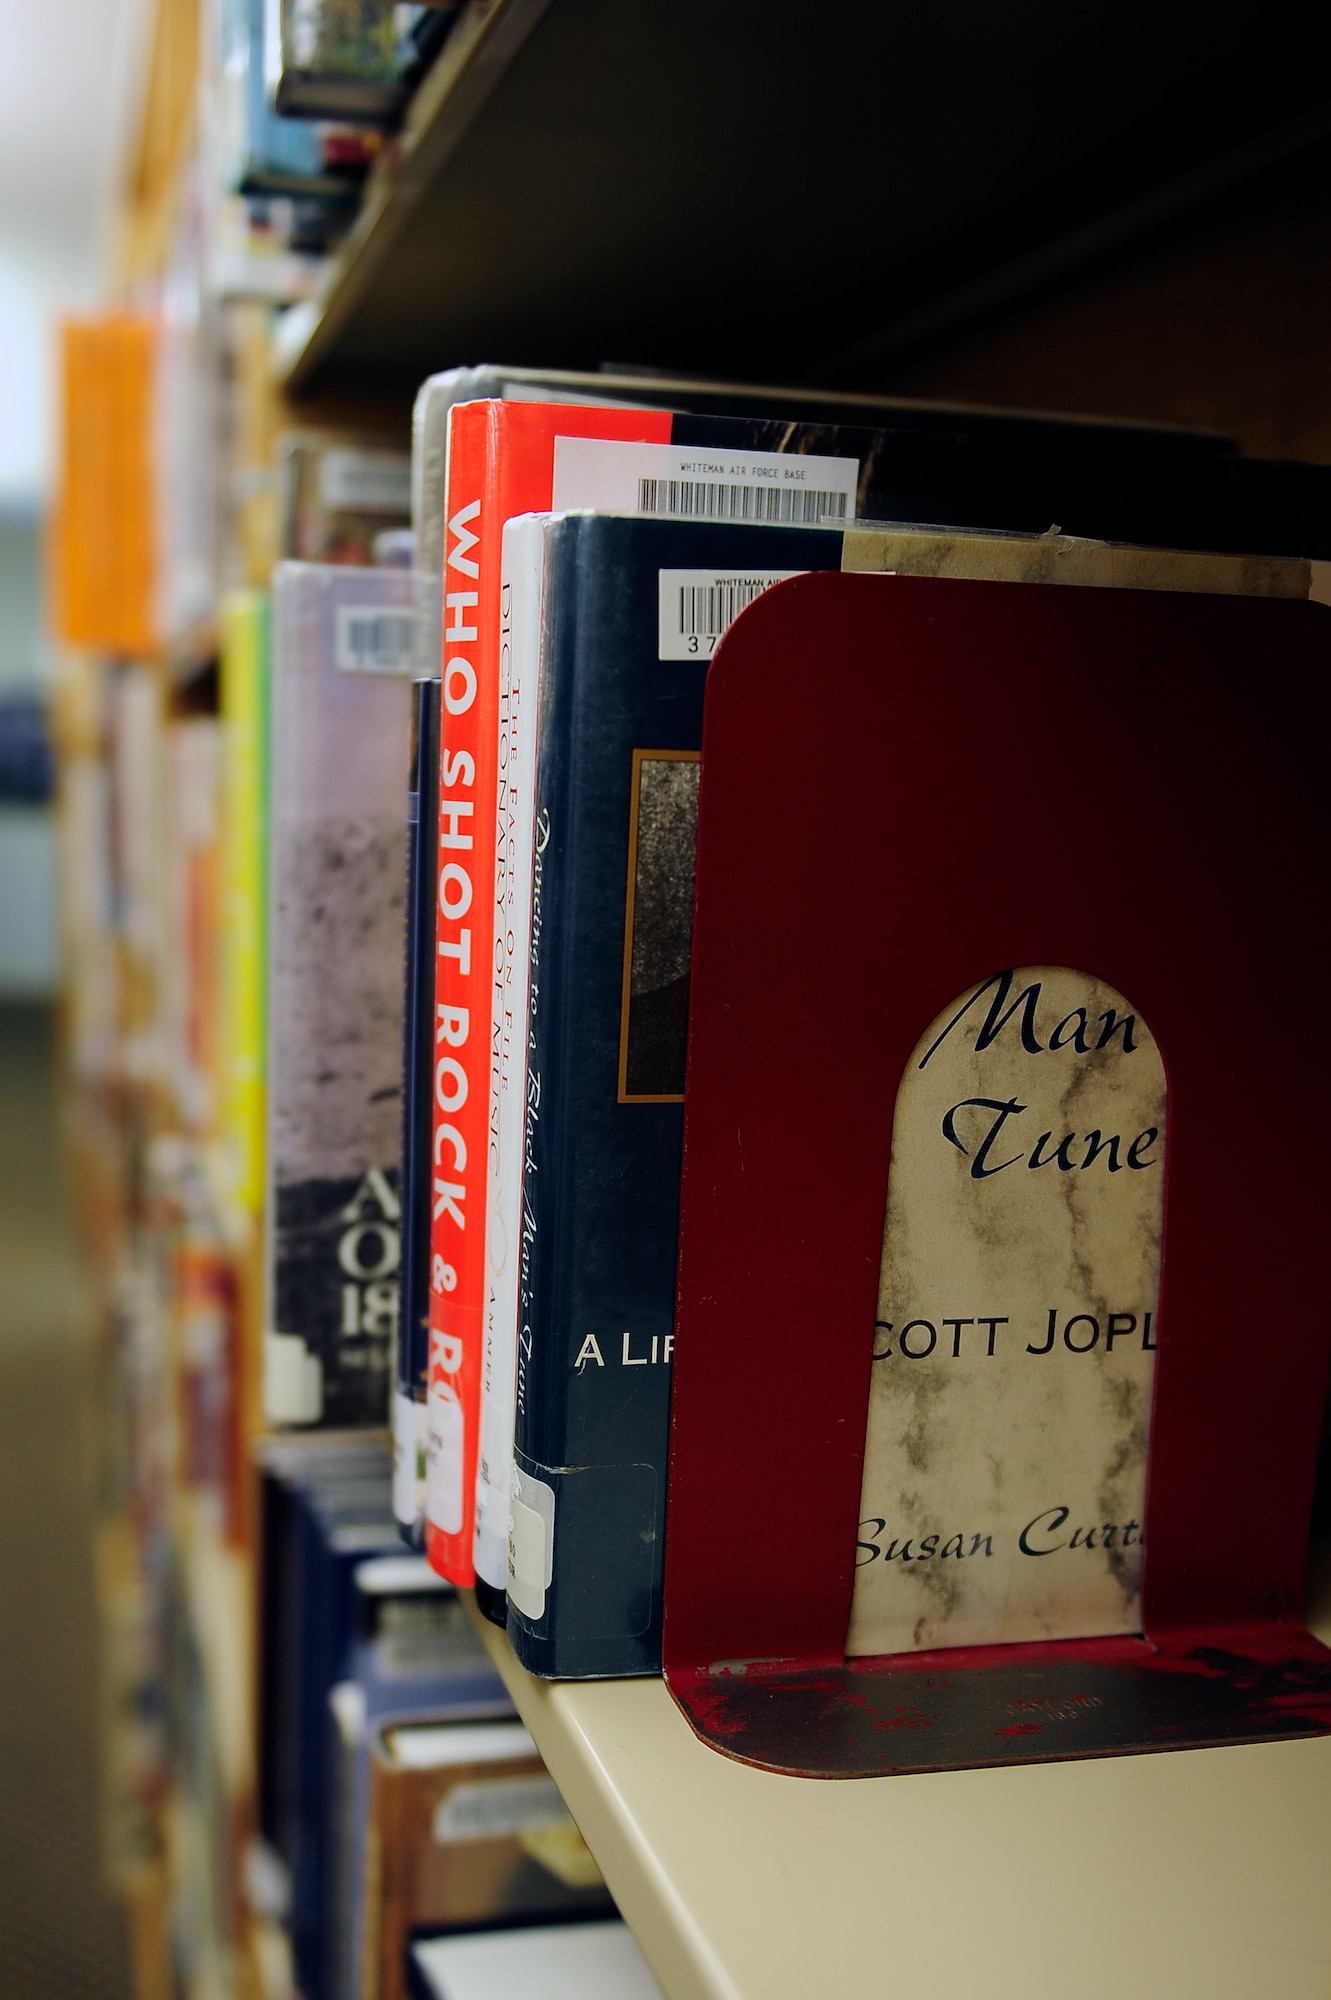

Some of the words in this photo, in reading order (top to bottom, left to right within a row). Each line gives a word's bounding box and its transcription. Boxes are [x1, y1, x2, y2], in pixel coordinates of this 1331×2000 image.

[680, 462, 725, 474] WHITEMAN
[729, 466, 747, 475] AIR
[752, 467, 779, 478] FORCE
[784, 470, 806, 480] BASE
[444, 498, 482, 716] WHO
[714, 578, 764, 586] WHITEMAN
[496, 582, 511, 915] DICTIONARY
[511, 678, 521, 762] THE
[438, 748, 476, 976] SHOT
[507, 786, 518, 905] FACTS
[530, 807, 551, 967] Dancing
[494, 937, 505, 1001] OF
[505, 929, 515, 985] ON
[530, 983, 540, 1016] to
[501, 1009, 513, 1091] FILE
[528, 1032, 537, 1050] a
[917, 969, 1139, 1070] Man
[433, 1003, 470, 1231] ROCK
[489, 1021, 501, 1178] MUSIC
[525, 1066, 541, 1174] Black
[941, 1096, 1160, 1179] Tune
[433, 1253, 458, 1296] &
[521, 1186, 538, 1308] Man's
[485, 1286, 496, 1393] AMMER
[517, 1324, 533, 1416] Tune
[573, 1333, 606, 1368] A
[855, 1517, 994, 1569] Susan
